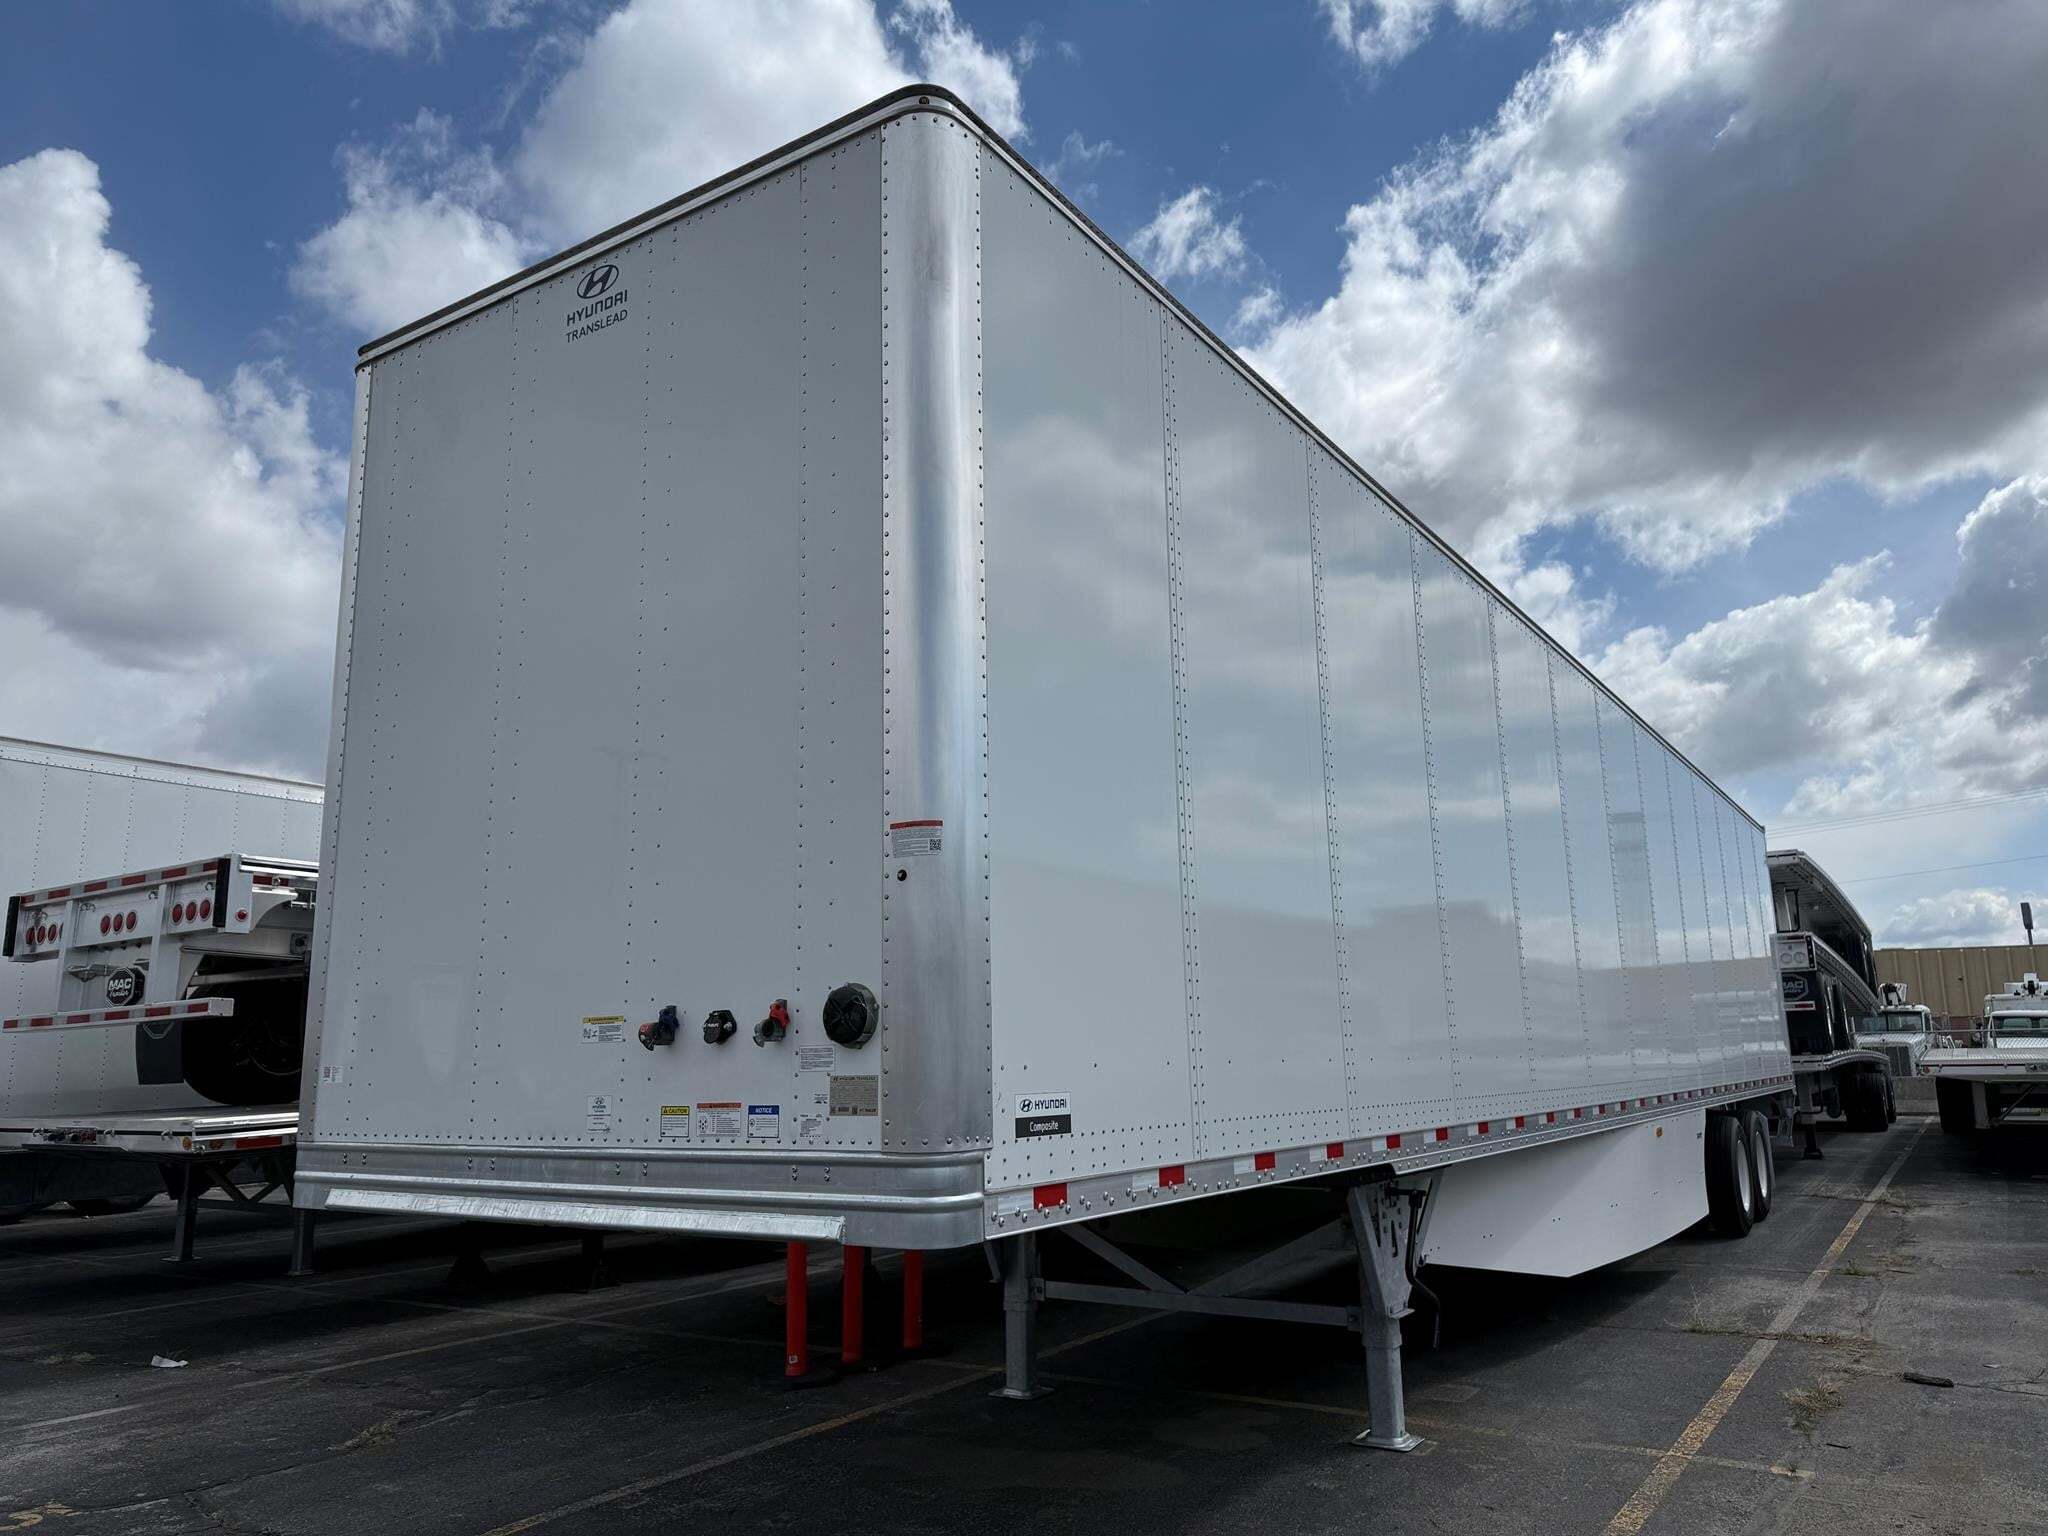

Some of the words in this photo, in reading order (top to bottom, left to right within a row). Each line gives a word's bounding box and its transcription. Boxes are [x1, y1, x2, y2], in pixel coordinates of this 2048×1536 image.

[566, 289, 628, 327] HYUNDAI
[566, 309, 628, 343] TRANSLEAD
[108, 977, 132, 991] MAC
[1034, 1098, 1067, 1110] HYUNDAI
[1029, 1120, 1059, 1132] Composite
